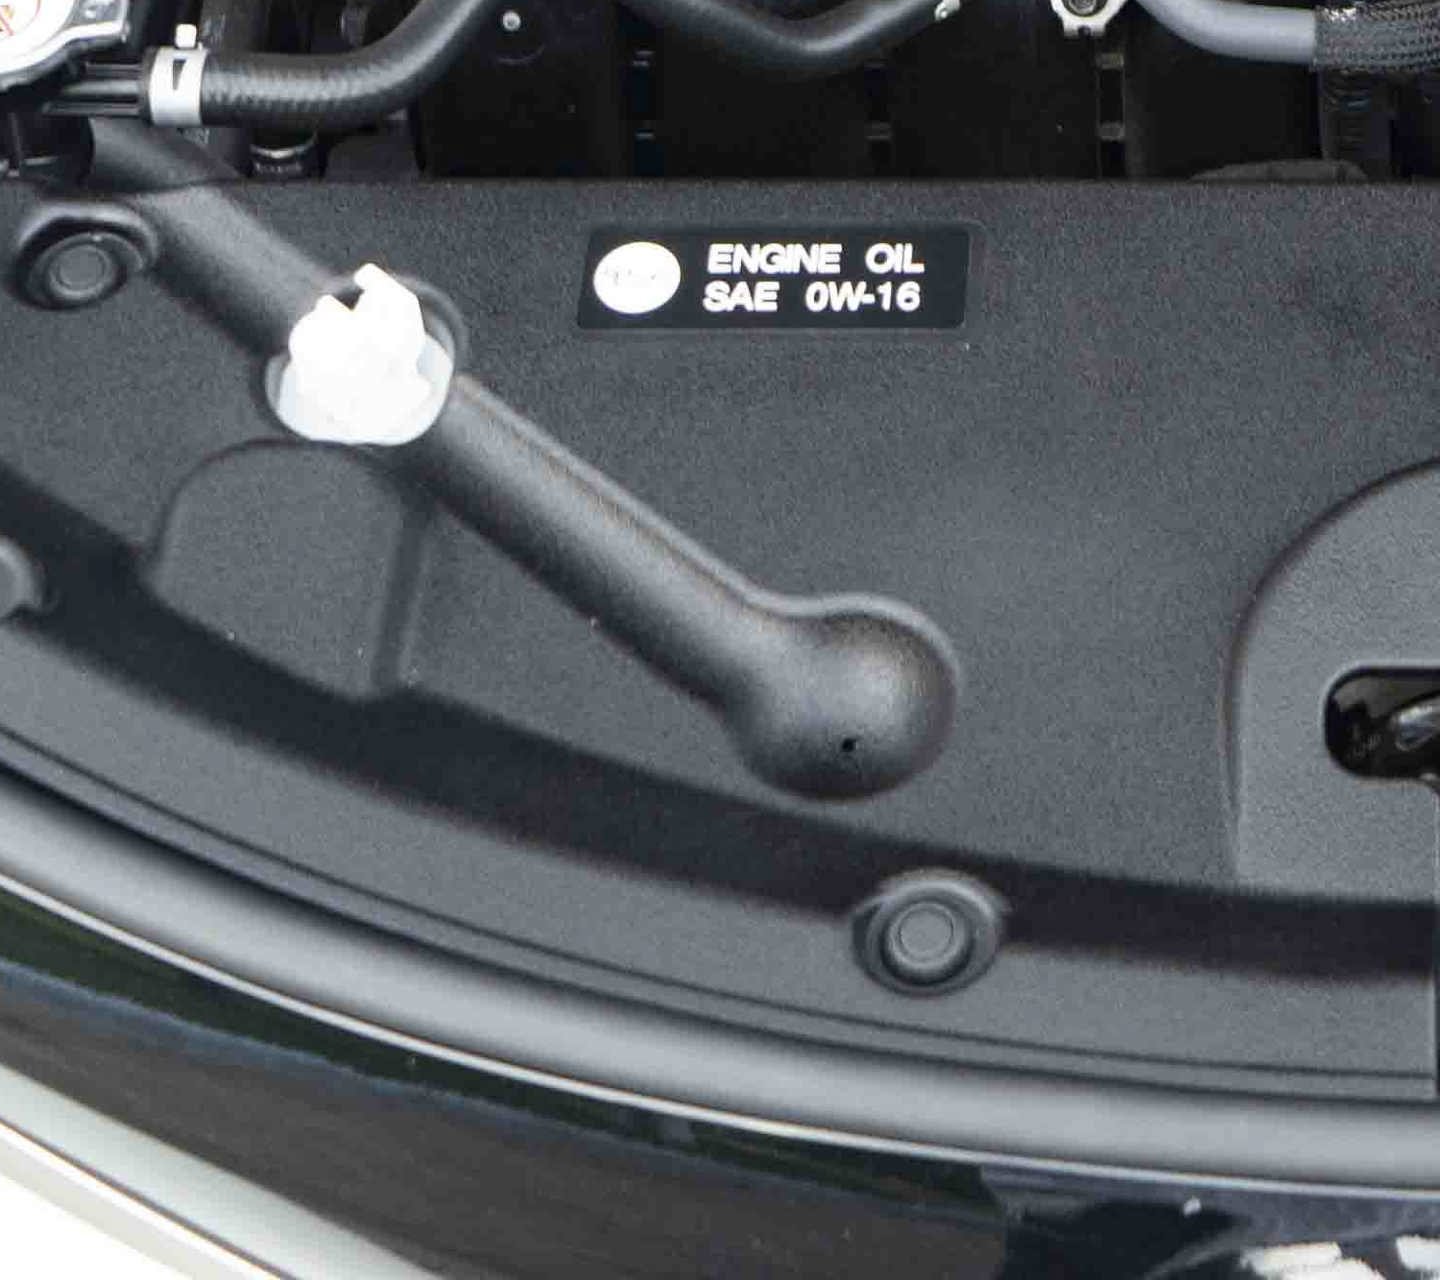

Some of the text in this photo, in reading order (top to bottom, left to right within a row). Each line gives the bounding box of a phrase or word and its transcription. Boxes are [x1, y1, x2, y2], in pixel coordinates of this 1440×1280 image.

[706, 242, 925, 275] ENGINE OIL
[702, 281, 921, 313] SAE 0W-16
